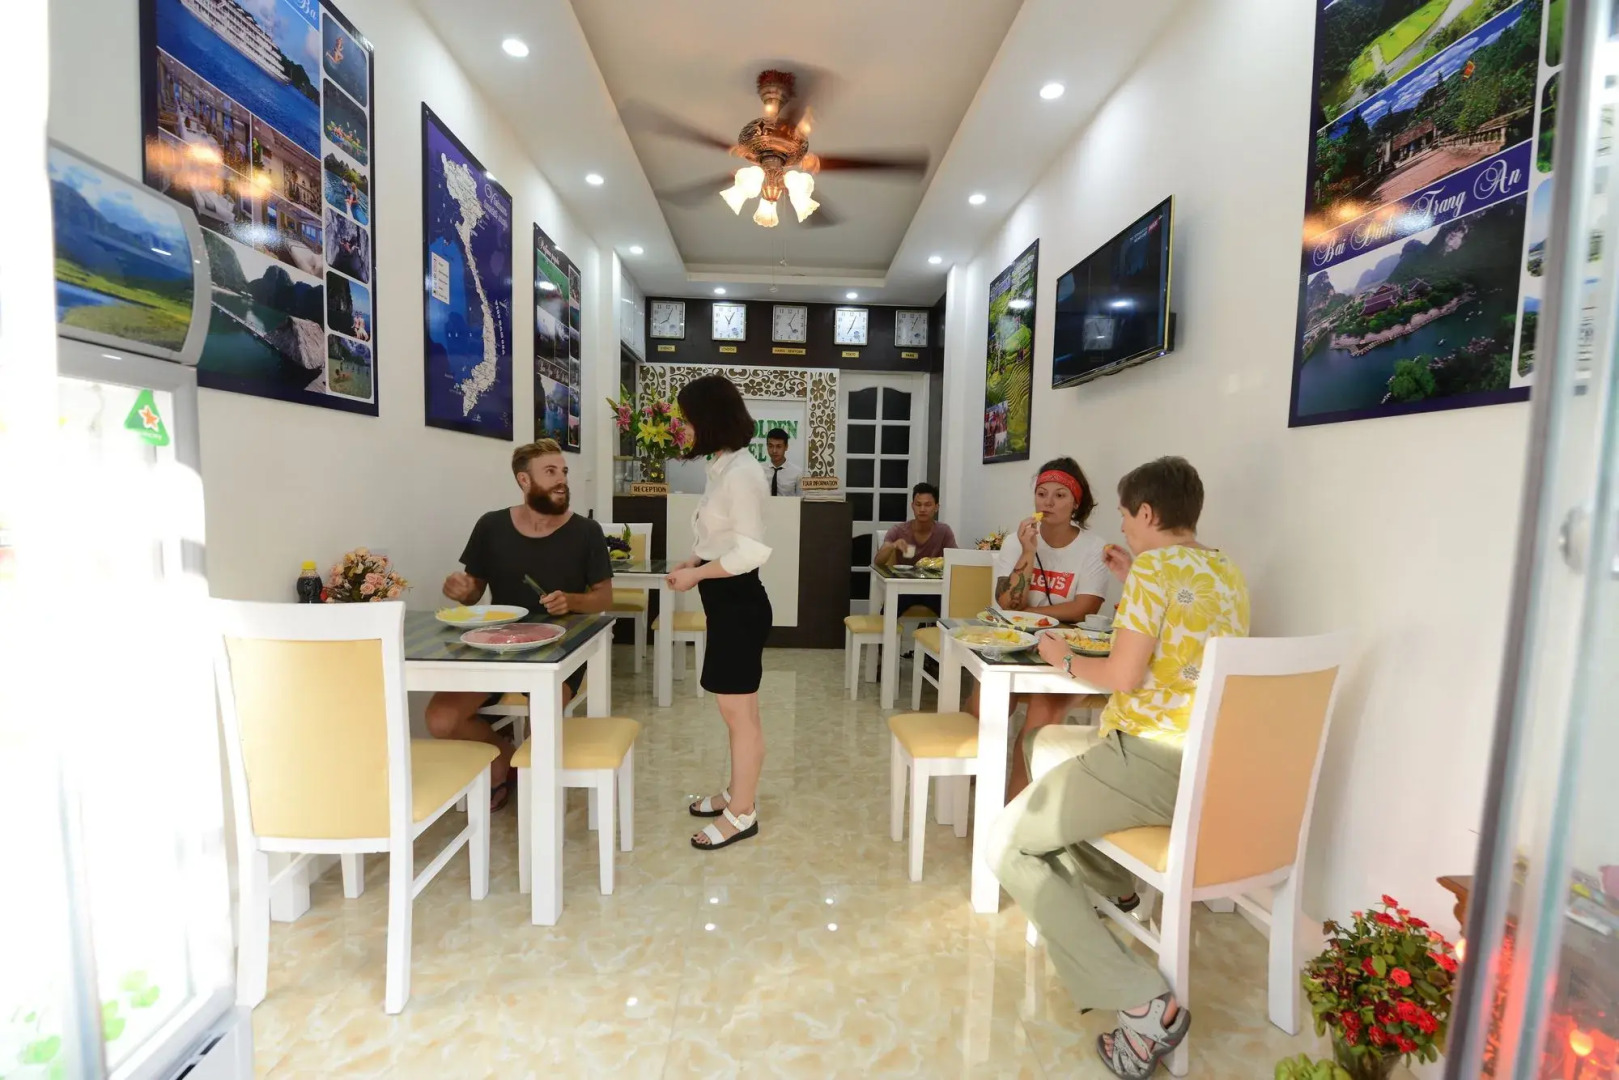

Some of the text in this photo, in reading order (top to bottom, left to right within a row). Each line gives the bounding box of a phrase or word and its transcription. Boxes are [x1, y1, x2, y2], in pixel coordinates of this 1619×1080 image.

[1313, 239, 1346, 267] Bai
[1409, 185, 1467, 219] Trang
[1473, 159, 1522, 200] An
